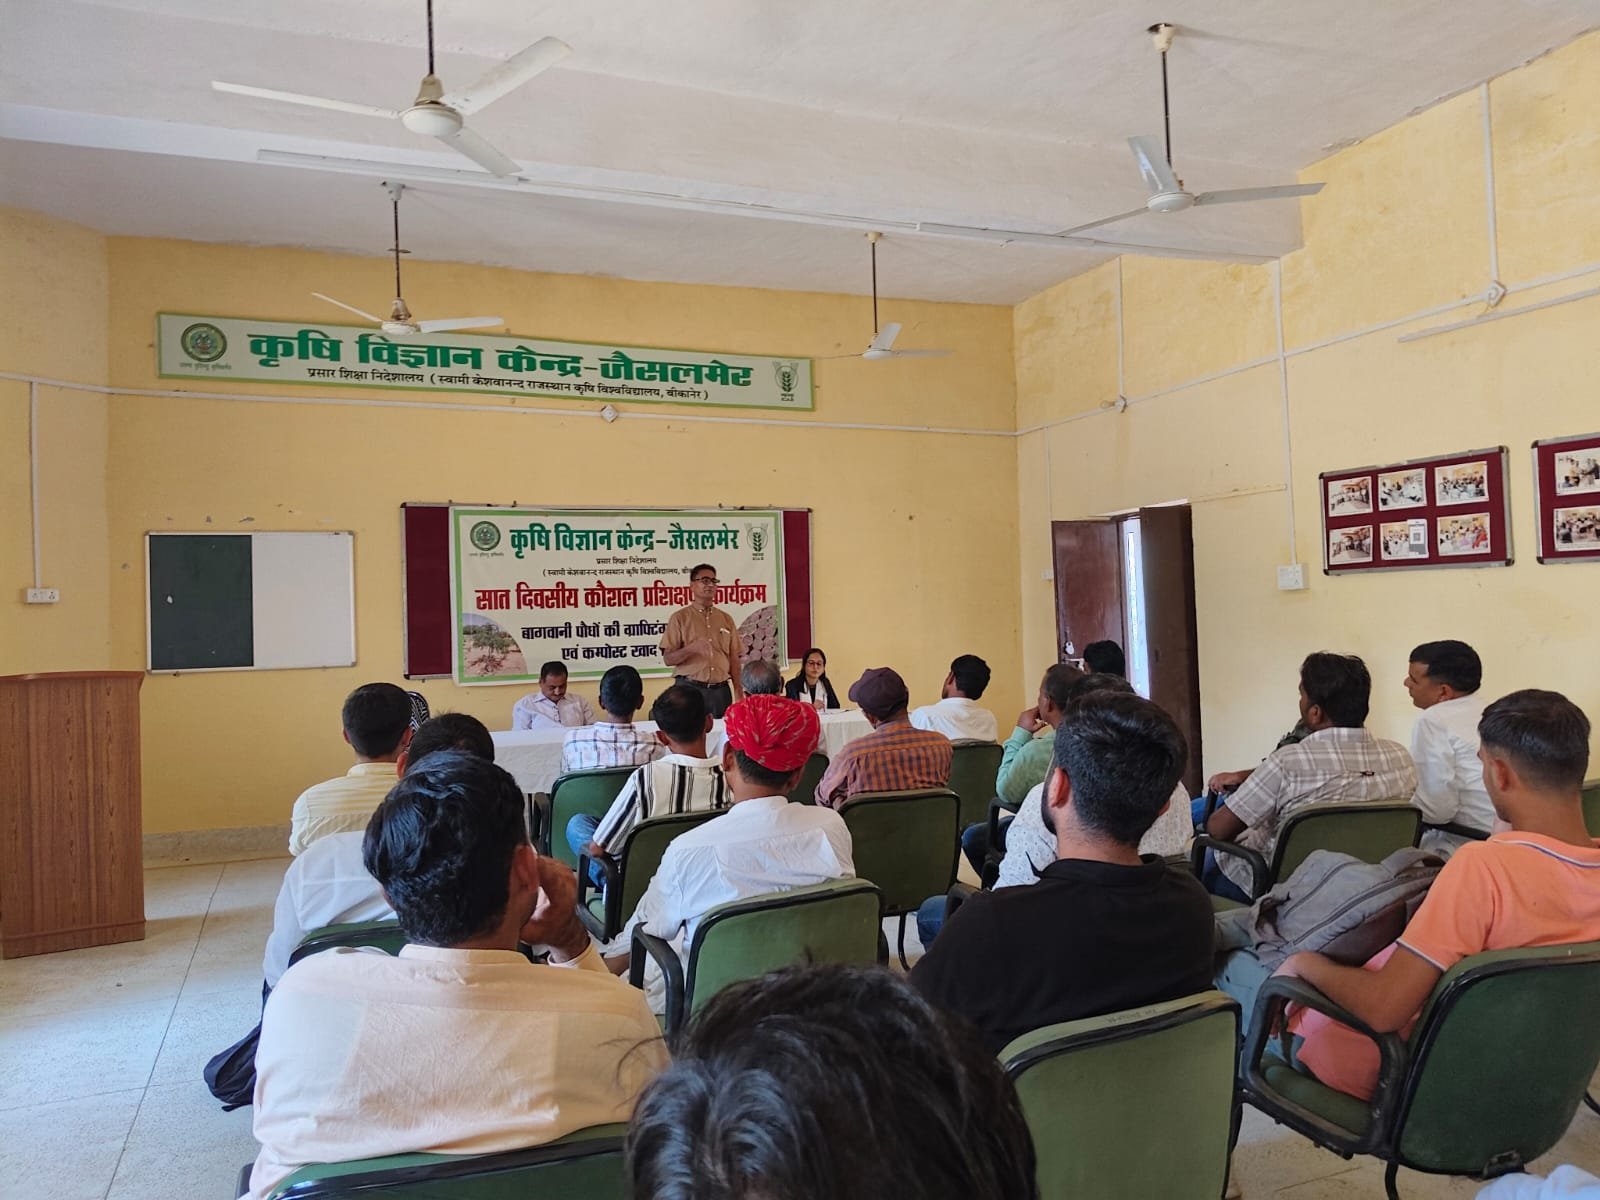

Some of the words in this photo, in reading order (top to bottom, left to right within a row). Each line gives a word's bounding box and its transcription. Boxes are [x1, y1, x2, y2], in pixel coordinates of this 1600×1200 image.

[247, 329, 343, 367] कृषि
[354, 333, 484, 369] विज्ञान
[307, 367, 337, 379] प्रसार
[339, 366, 369, 380] शिक्षा
[371, 368, 424, 383] निदेशालय
[472, 371, 524, 390] केशवानन्द
[526, 378, 571, 393] राजस्थान
[573, 381, 595, 396] कृषि
[509, 523, 551, 559] कृषि
[554, 523, 613, 551] विज्ञान
[475, 589, 511, 610] सात
[515, 581, 579, 609] दिवसीय
[584, 580, 637, 607] कौशल
[521, 622, 572, 639] बागवानी
[603, 620, 620, 637] की
[561, 643, 580, 660] एवं
[582, 643, 628, 660] कम्पोस्ट
[631, 644, 658, 658] खाद
